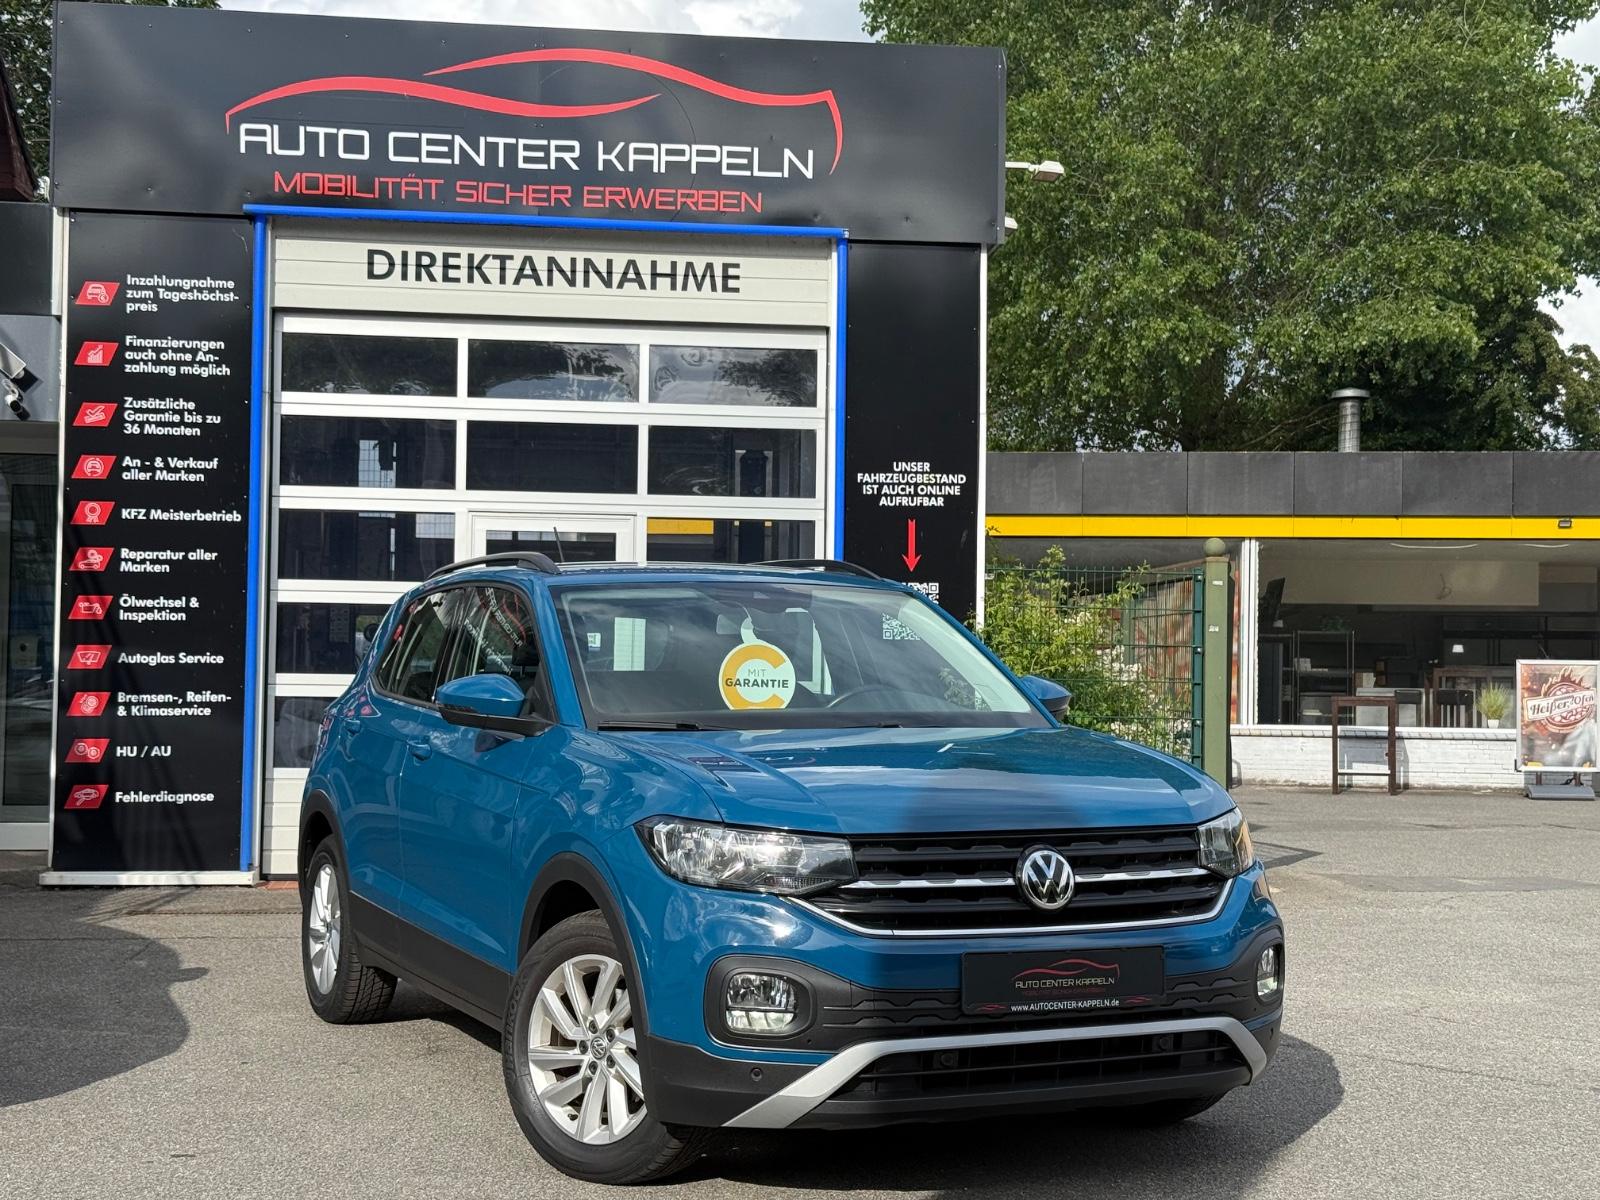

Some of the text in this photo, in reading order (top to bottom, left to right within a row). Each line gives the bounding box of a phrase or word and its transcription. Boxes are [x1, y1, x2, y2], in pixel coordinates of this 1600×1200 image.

[239, 123, 814, 179] AUTO CENTER KAPPELN
[274, 171, 763, 214] MOBILITÄT SICHER ERWERBEN
[366, 249, 742, 294] DIREKTANNAHME
[126, 274, 235, 289] Inzahlungnahme
[126, 288, 239, 302] zum Tageshöchst-
[126, 301, 158, 314] preis
[125, 336, 225, 350] Finanzierungen
[125, 349, 219, 362] auch ohne An-
[124, 362, 231, 377] zahlung möglich
[124, 397, 195, 410] Zusätzliche
[123, 410, 221, 424] Garantie bis zu
[123, 424, 201, 436] 36 Monaten
[122, 456, 141, 467] An
[154, 457, 164, 468] &
[167, 457, 219, 469] Verkauf
[893, 461, 930, 472] UNSER
[121, 469, 205, 481] aller Marken
[857, 473, 967, 484] FAHRZEUGBESTAND
[862, 485, 961, 496] IST AUCH ONLINE
[879, 496, 944, 507] AUFRUFBAR
[121, 508, 242, 522] KFZ Meisterbetrieb
[120, 548, 217, 562] Reparatur aller
[120, 561, 170, 572] Marken
[119, 594, 200, 608] Ölwechsel &
[119, 610, 186, 623] Inspektion
[118, 652, 224, 666] Autoglas Service
[748, 668, 766, 678] MIT
[725, 678, 789, 689] GARANTIE
[117, 691, 232, 704] Bremsen-, Reifen-
[117, 705, 211, 717] & Klimaservice
[116, 746, 171, 758] HU / AU
[115, 791, 215, 804] Fehlerdiagnose
[1015, 977, 1115, 989] AUTO CENTER KAPPELN
[1011, 999, 1120, 1012] www.AUTOCENTER-KAPPELN.de
